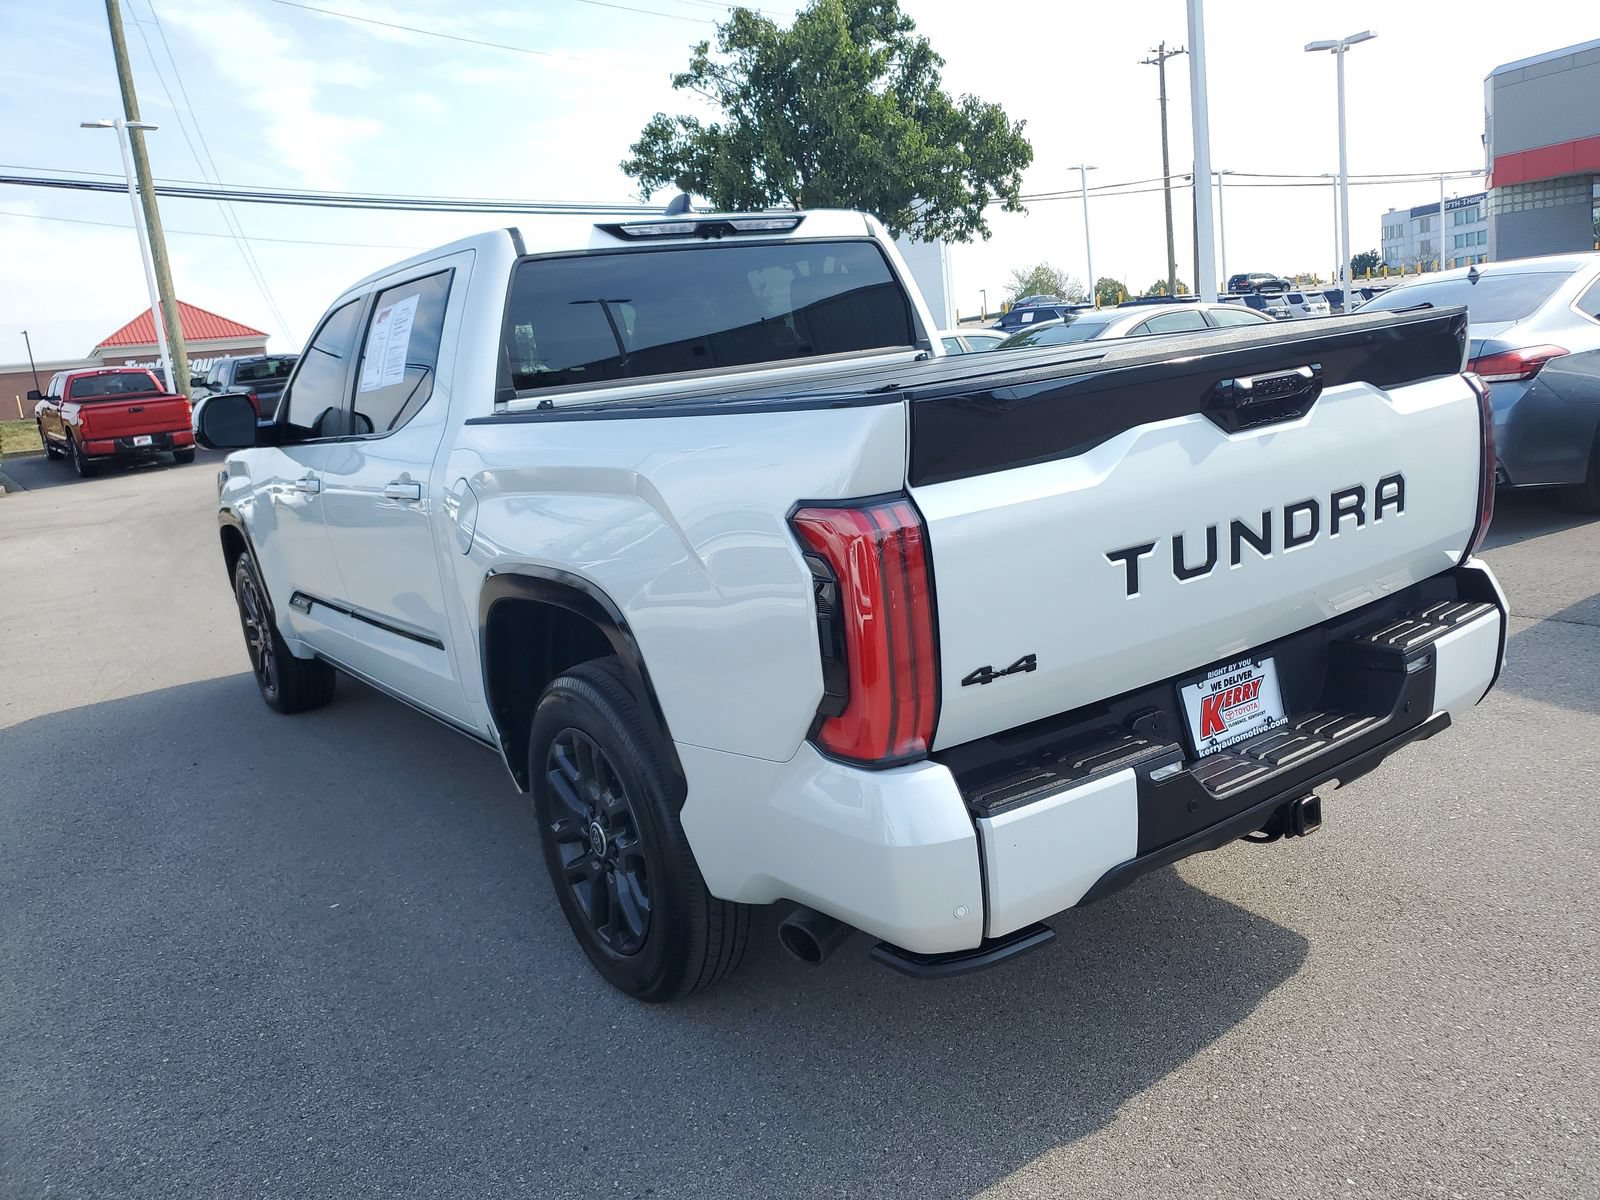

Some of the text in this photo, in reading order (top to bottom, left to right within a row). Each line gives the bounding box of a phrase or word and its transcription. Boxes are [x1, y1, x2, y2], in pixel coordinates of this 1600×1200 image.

[1102, 473, 1406, 600] TUNDRA
[1207, 658, 1252, 679] RIGHT BY YOU
[1211, 670, 1253, 692] WE DELIVER
[1201, 676, 1263, 740] KERRY
[1234, 701, 1258, 716] TOYOTA
[1198, 717, 1289, 758] kerryautomotive.com
